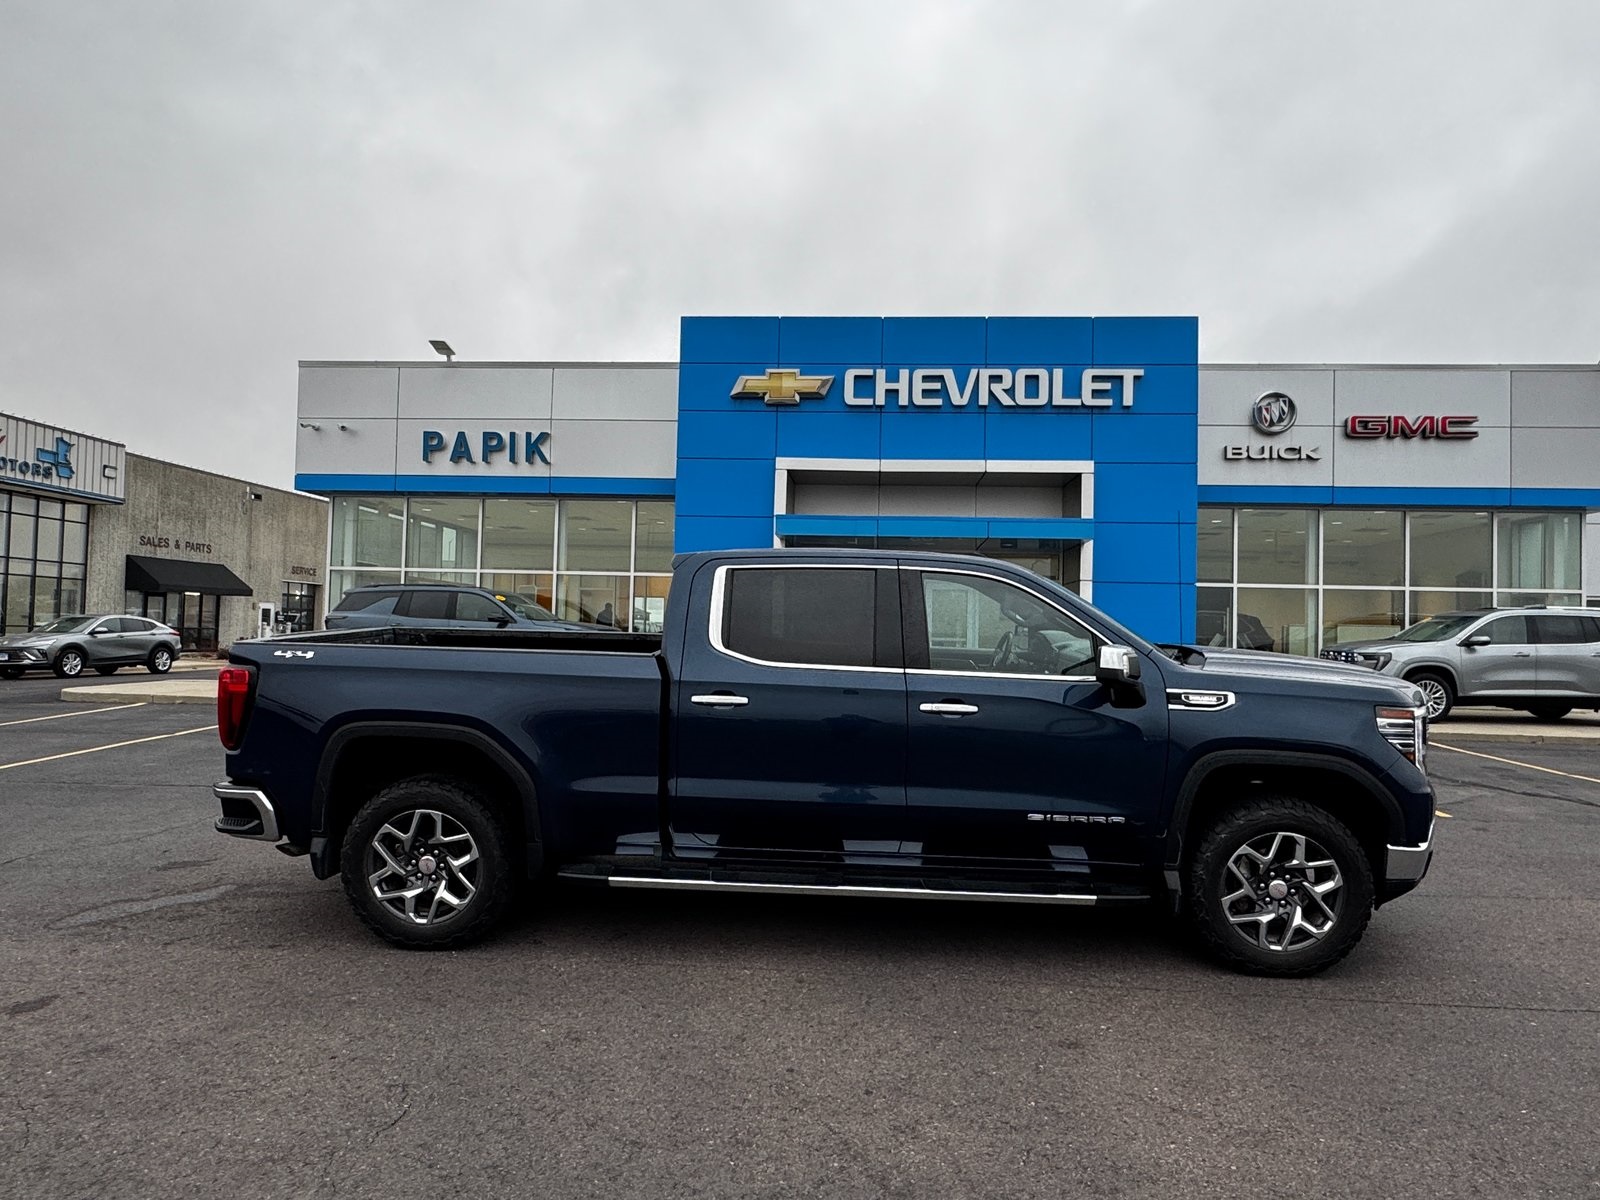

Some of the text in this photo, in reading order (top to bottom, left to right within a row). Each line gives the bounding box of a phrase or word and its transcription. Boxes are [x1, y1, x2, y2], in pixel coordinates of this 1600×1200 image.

[843, 368, 1145, 408] CHEVROLET
[1345, 414, 1479, 440] GMC
[422, 430, 551, 465] PAPIK
[1224, 445, 1321, 461] BUICK
[139, 535, 212, 554] SALES & PARTS
[291, 566, 317, 576] SERVICE
[1027, 813, 1126, 824] SIERRA
